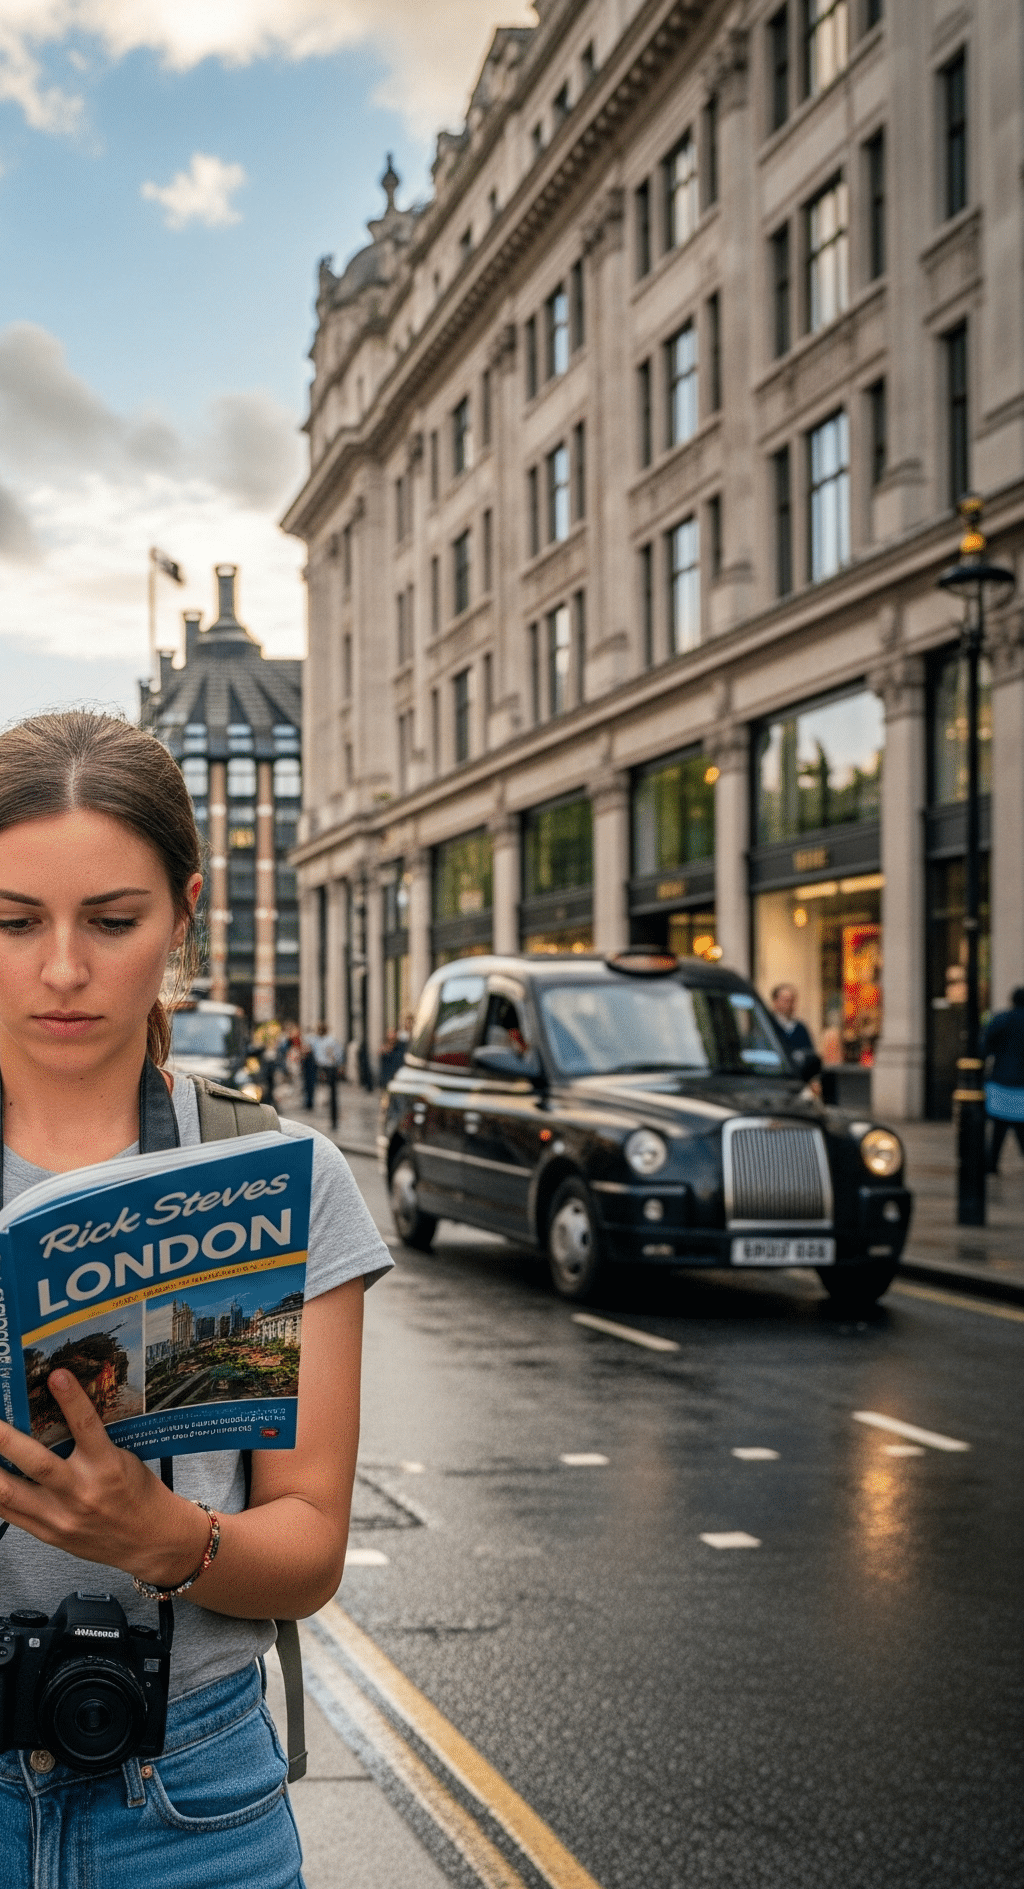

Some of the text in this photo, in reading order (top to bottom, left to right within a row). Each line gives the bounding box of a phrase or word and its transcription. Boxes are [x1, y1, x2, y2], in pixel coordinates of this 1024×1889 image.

[37, 1207, 292, 1317] LONDON
[39, 1173, 291, 1259] Rick Steves
